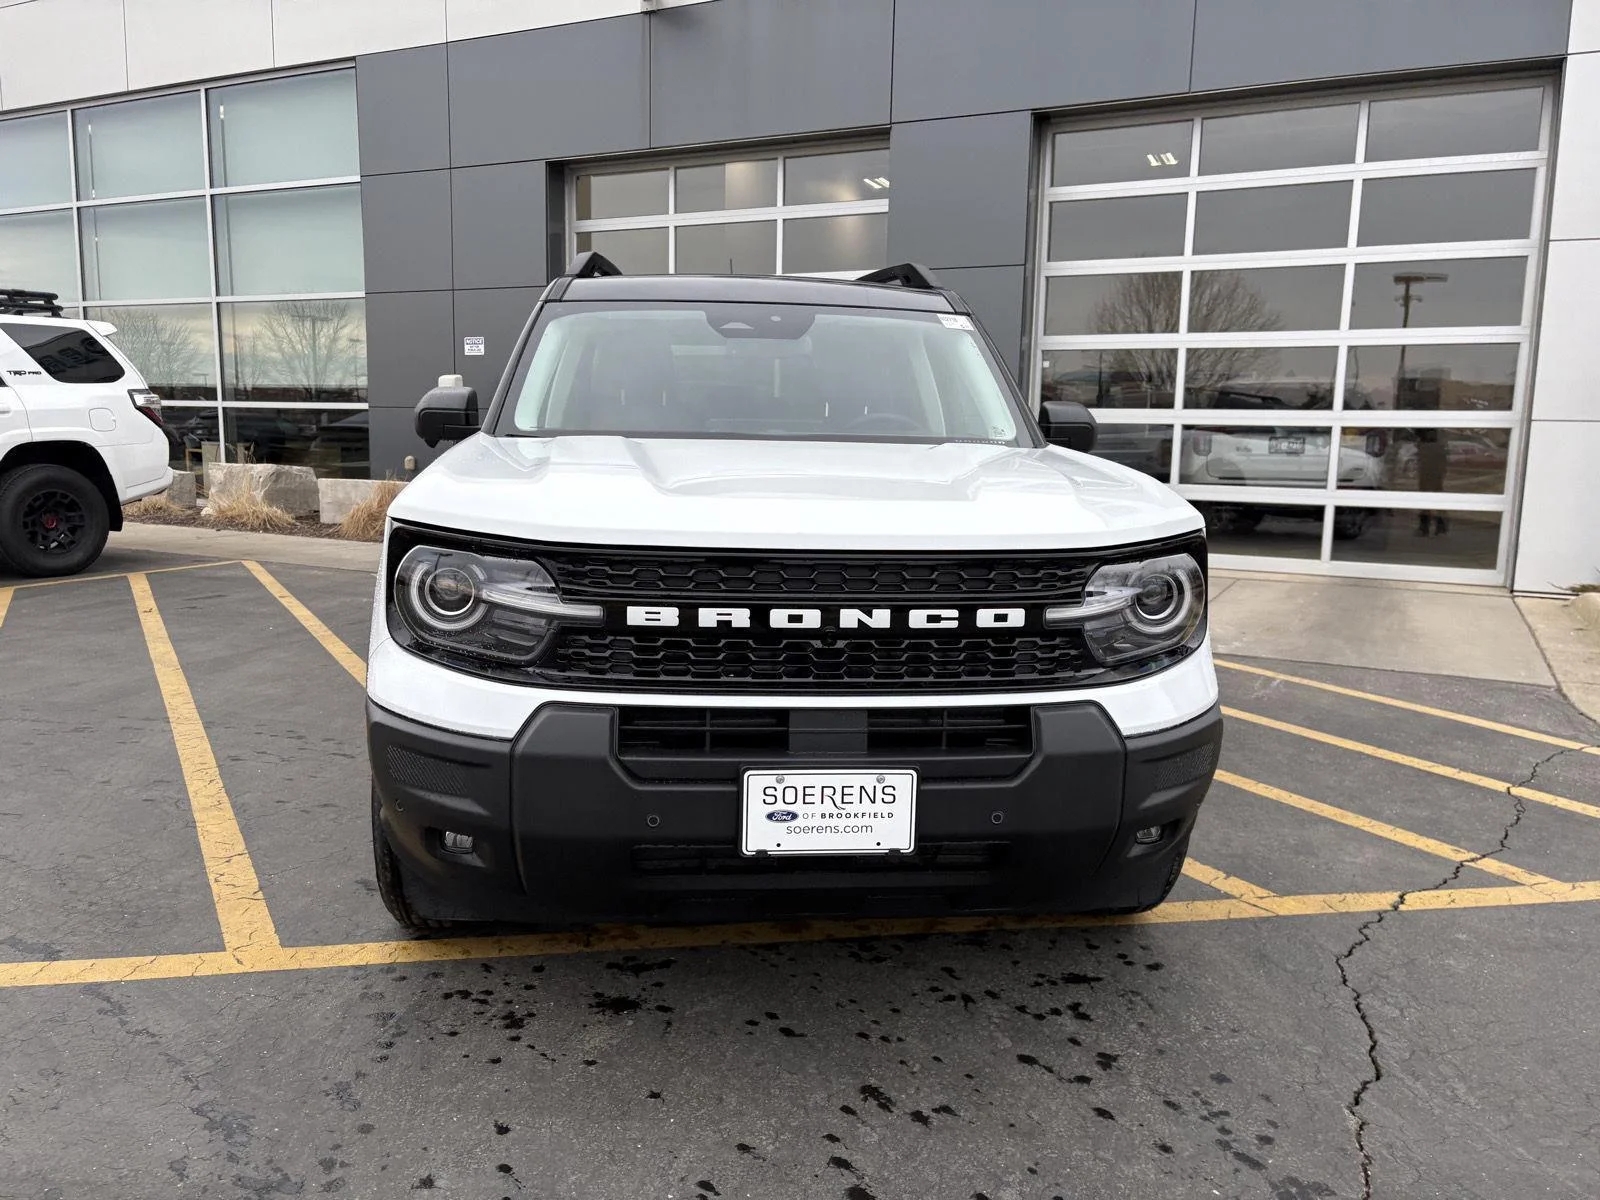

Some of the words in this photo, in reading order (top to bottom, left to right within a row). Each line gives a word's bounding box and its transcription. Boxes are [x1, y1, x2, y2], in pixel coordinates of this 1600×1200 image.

[626, 606, 1026, 628] BRONCO
[762, 785, 896, 810] SOERENS
[820, 811, 894, 819] BROOKFIELD
[786, 824, 873, 834] soerens.com
